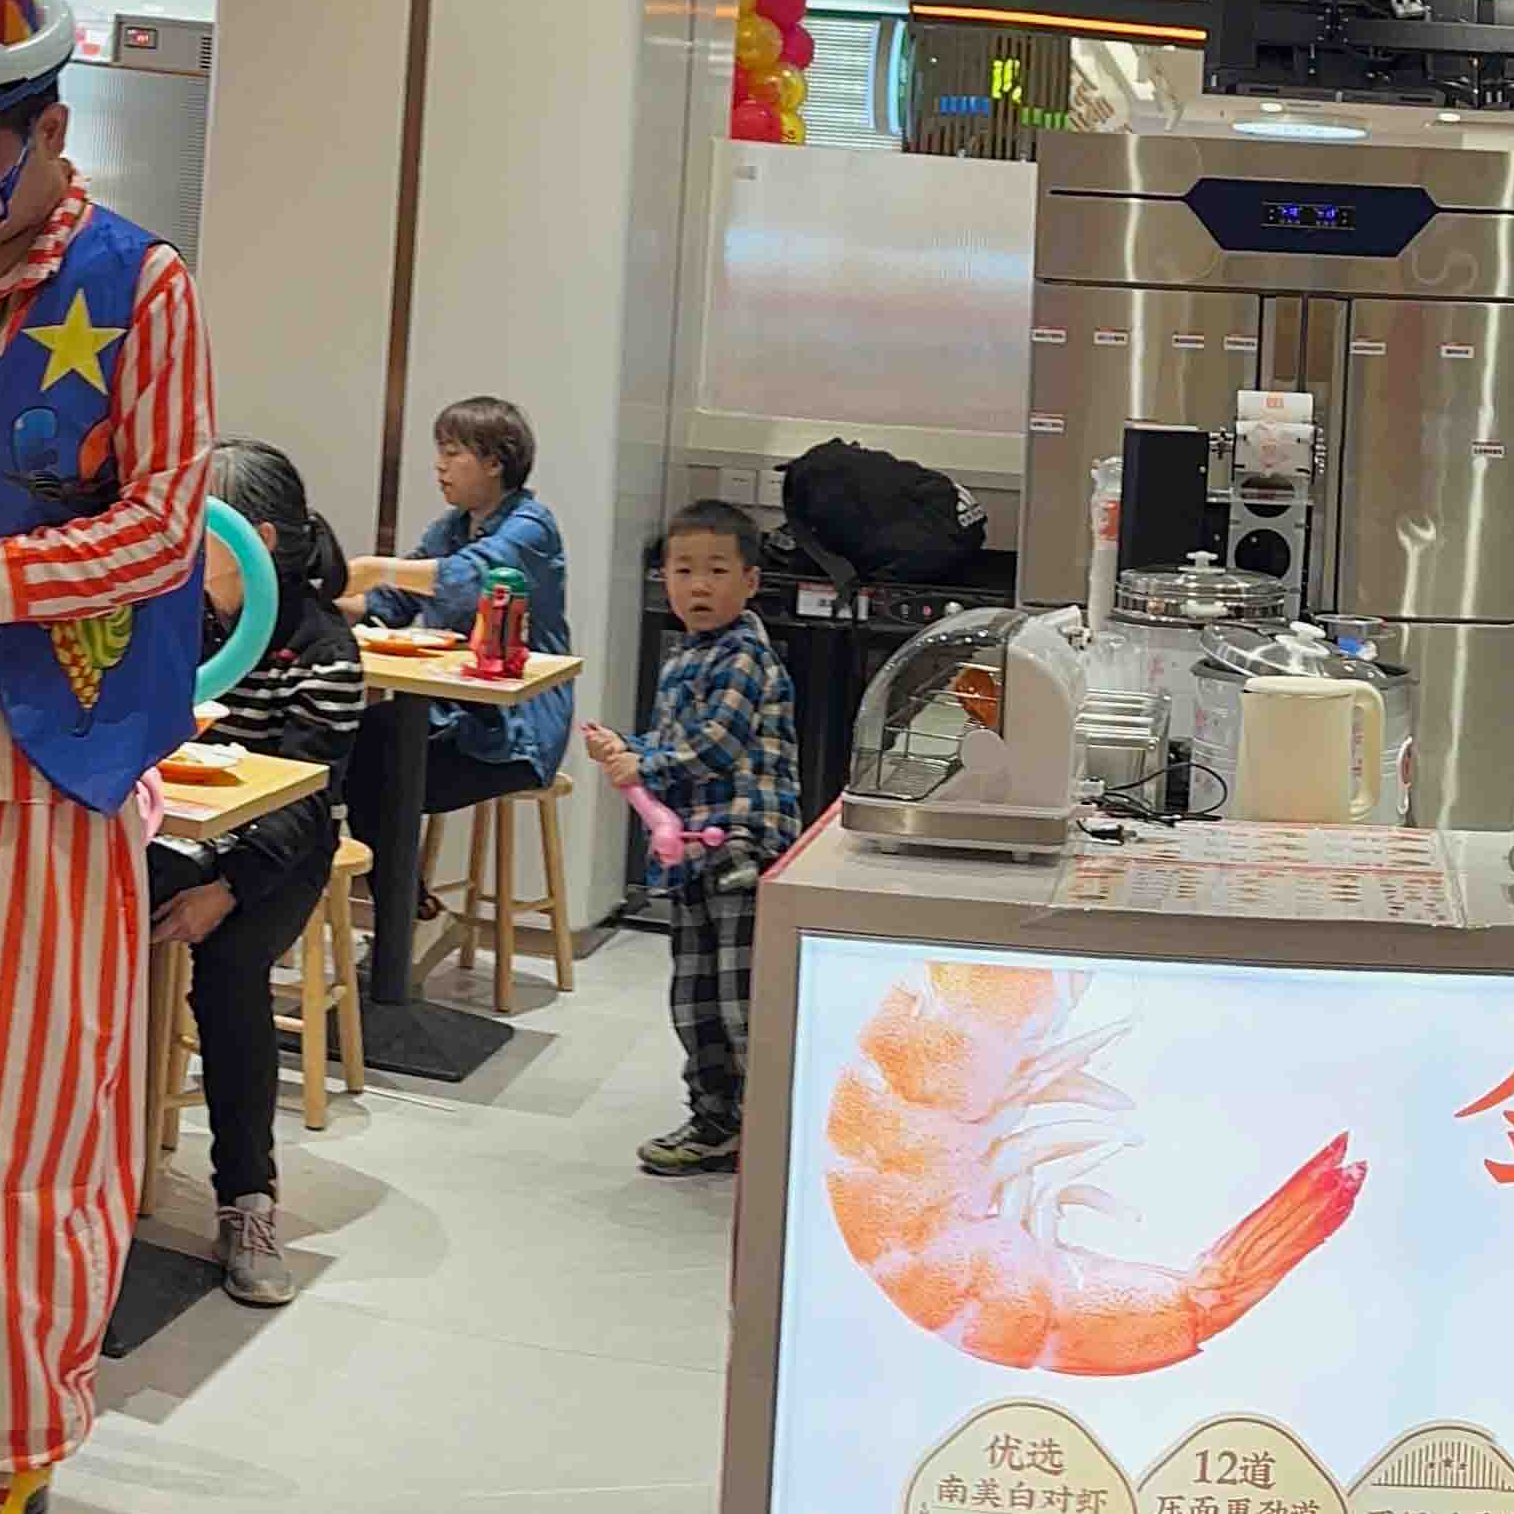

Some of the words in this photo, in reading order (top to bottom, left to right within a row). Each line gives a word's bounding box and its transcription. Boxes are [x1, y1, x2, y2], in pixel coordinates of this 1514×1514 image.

[985, 1432, 1068, 1474] 优选
[1193, 1449, 1277, 1489] 12道
[936, 1472, 1108, 1514] 南美白对虾
